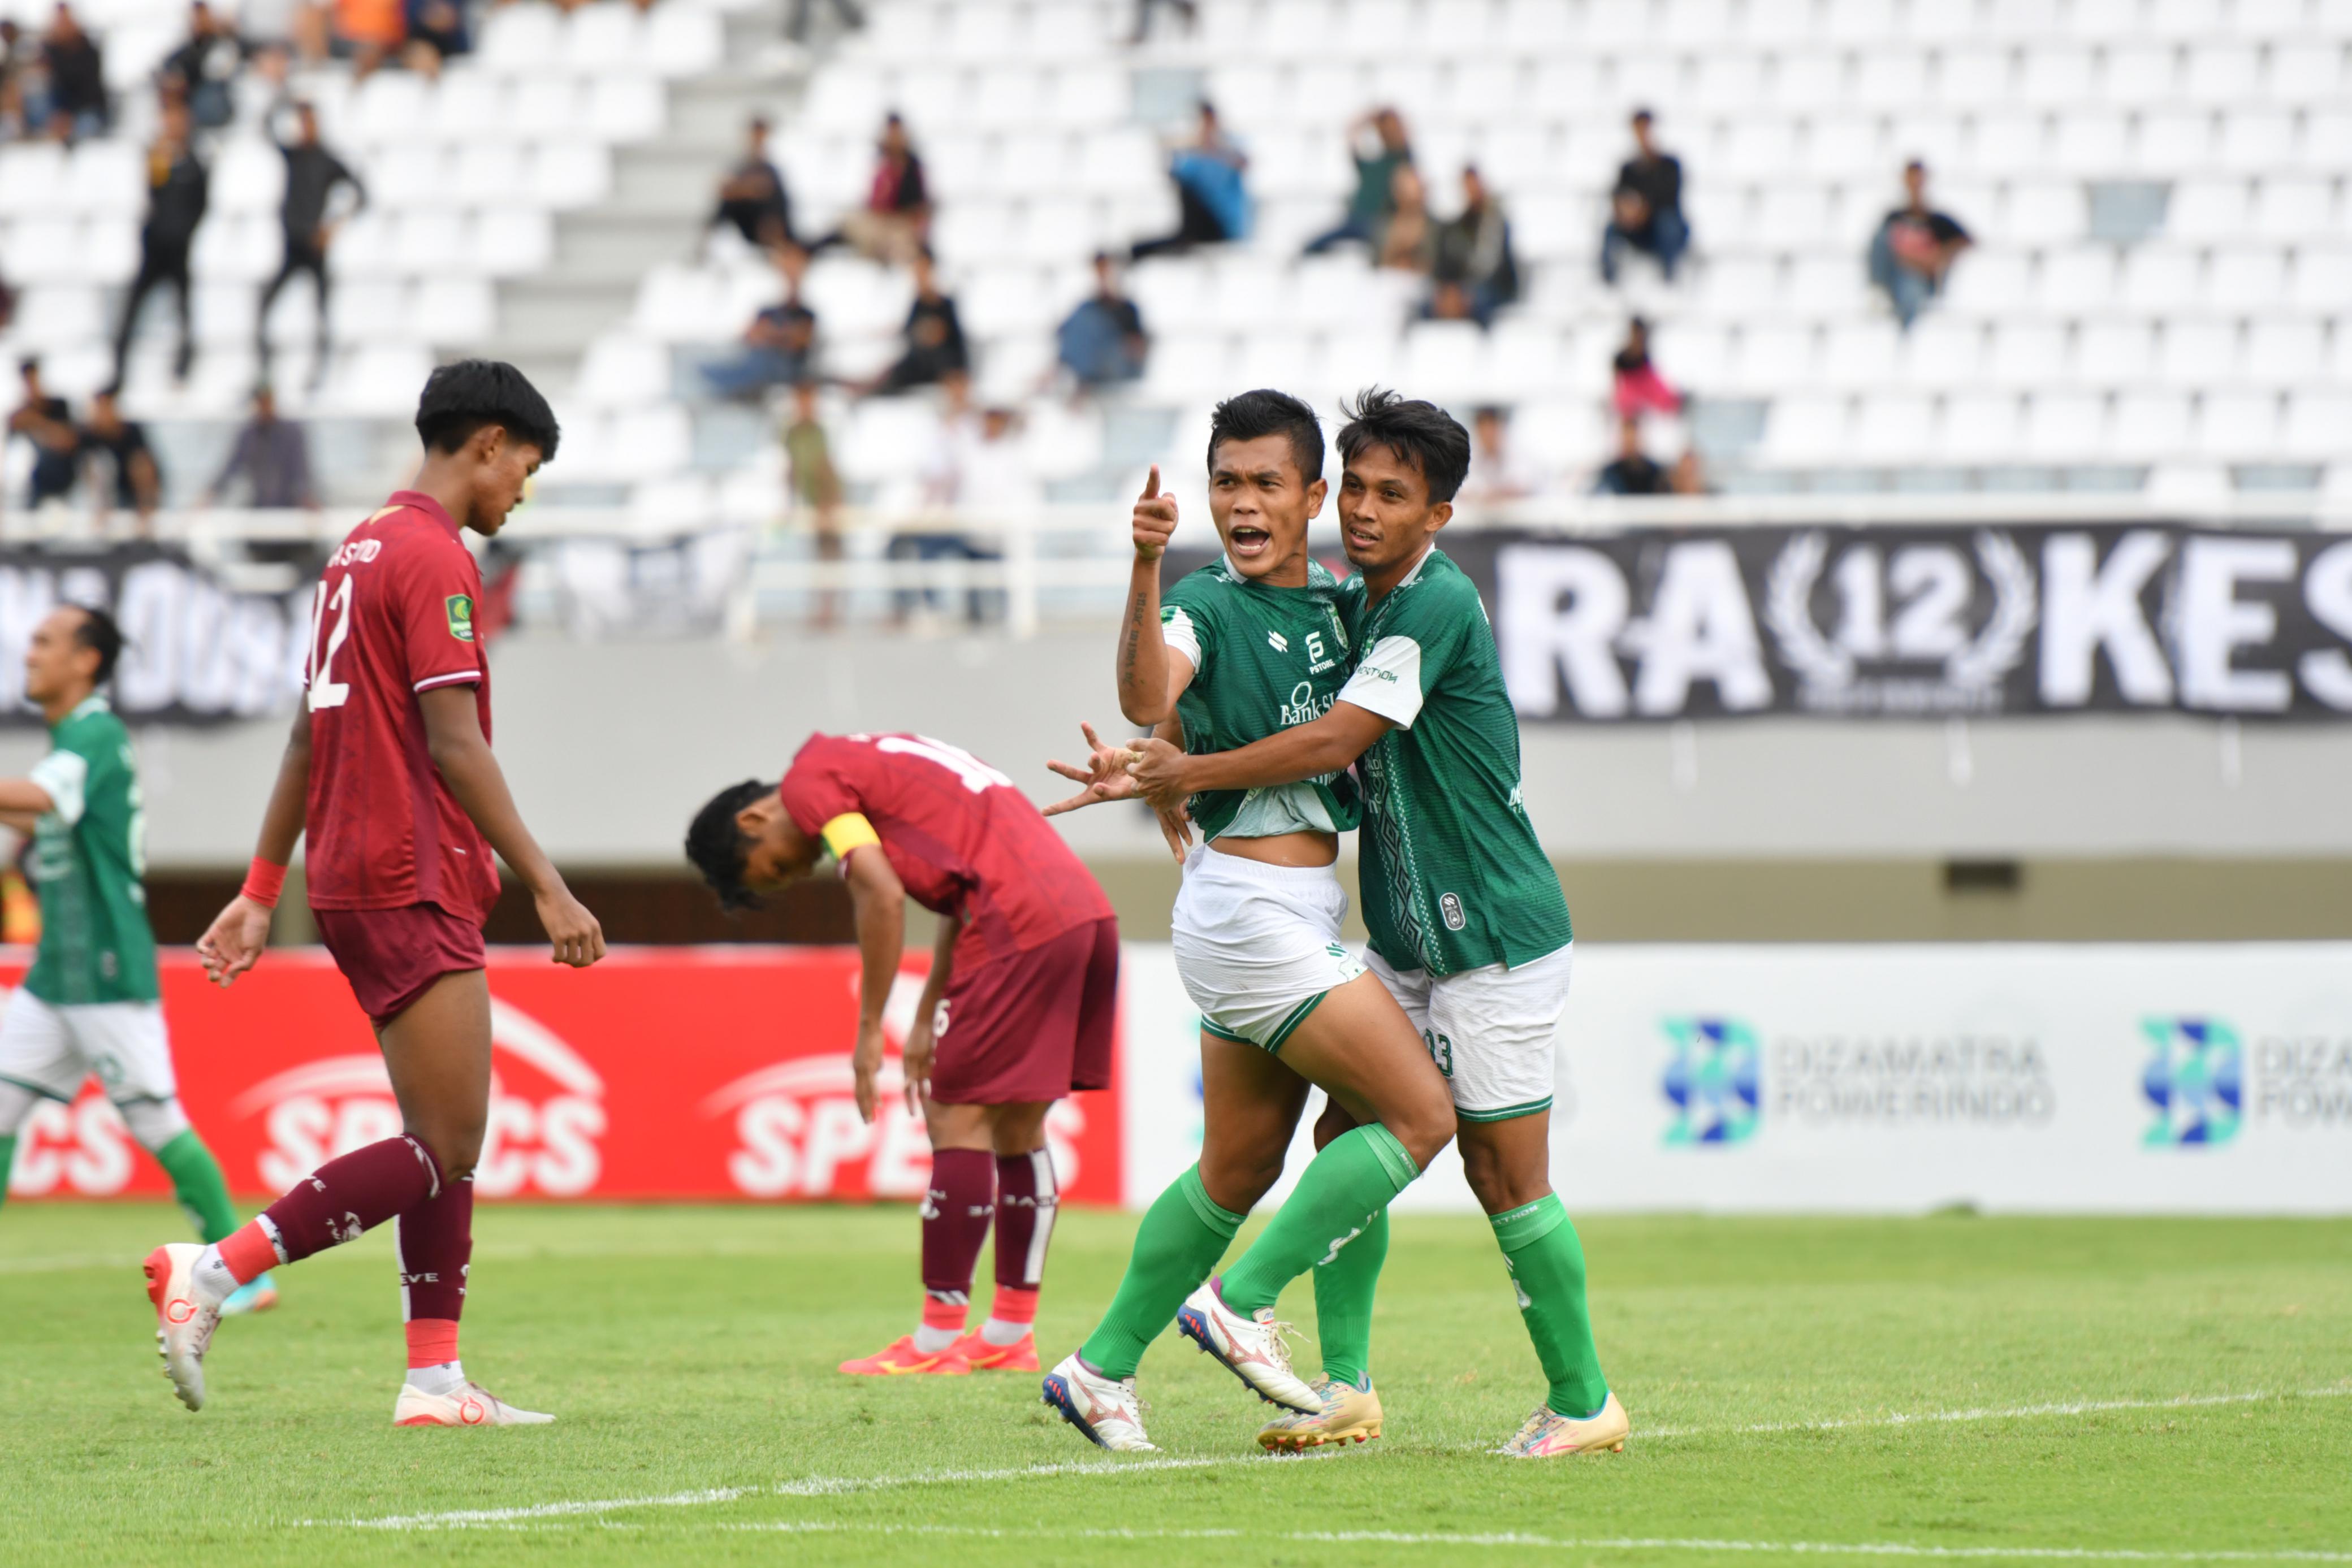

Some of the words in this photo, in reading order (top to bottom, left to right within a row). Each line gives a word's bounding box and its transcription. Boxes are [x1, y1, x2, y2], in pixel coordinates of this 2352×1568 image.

[308, 573, 353, 713] 12
[1309, 659, 1336, 675] PSTORE
[1497, 540, 1774, 718] RA
[1830, 541, 1973, 659] 12
[258, 1097, 606, 1197] SPCS
[729, 1098, 1086, 1197] SPES
